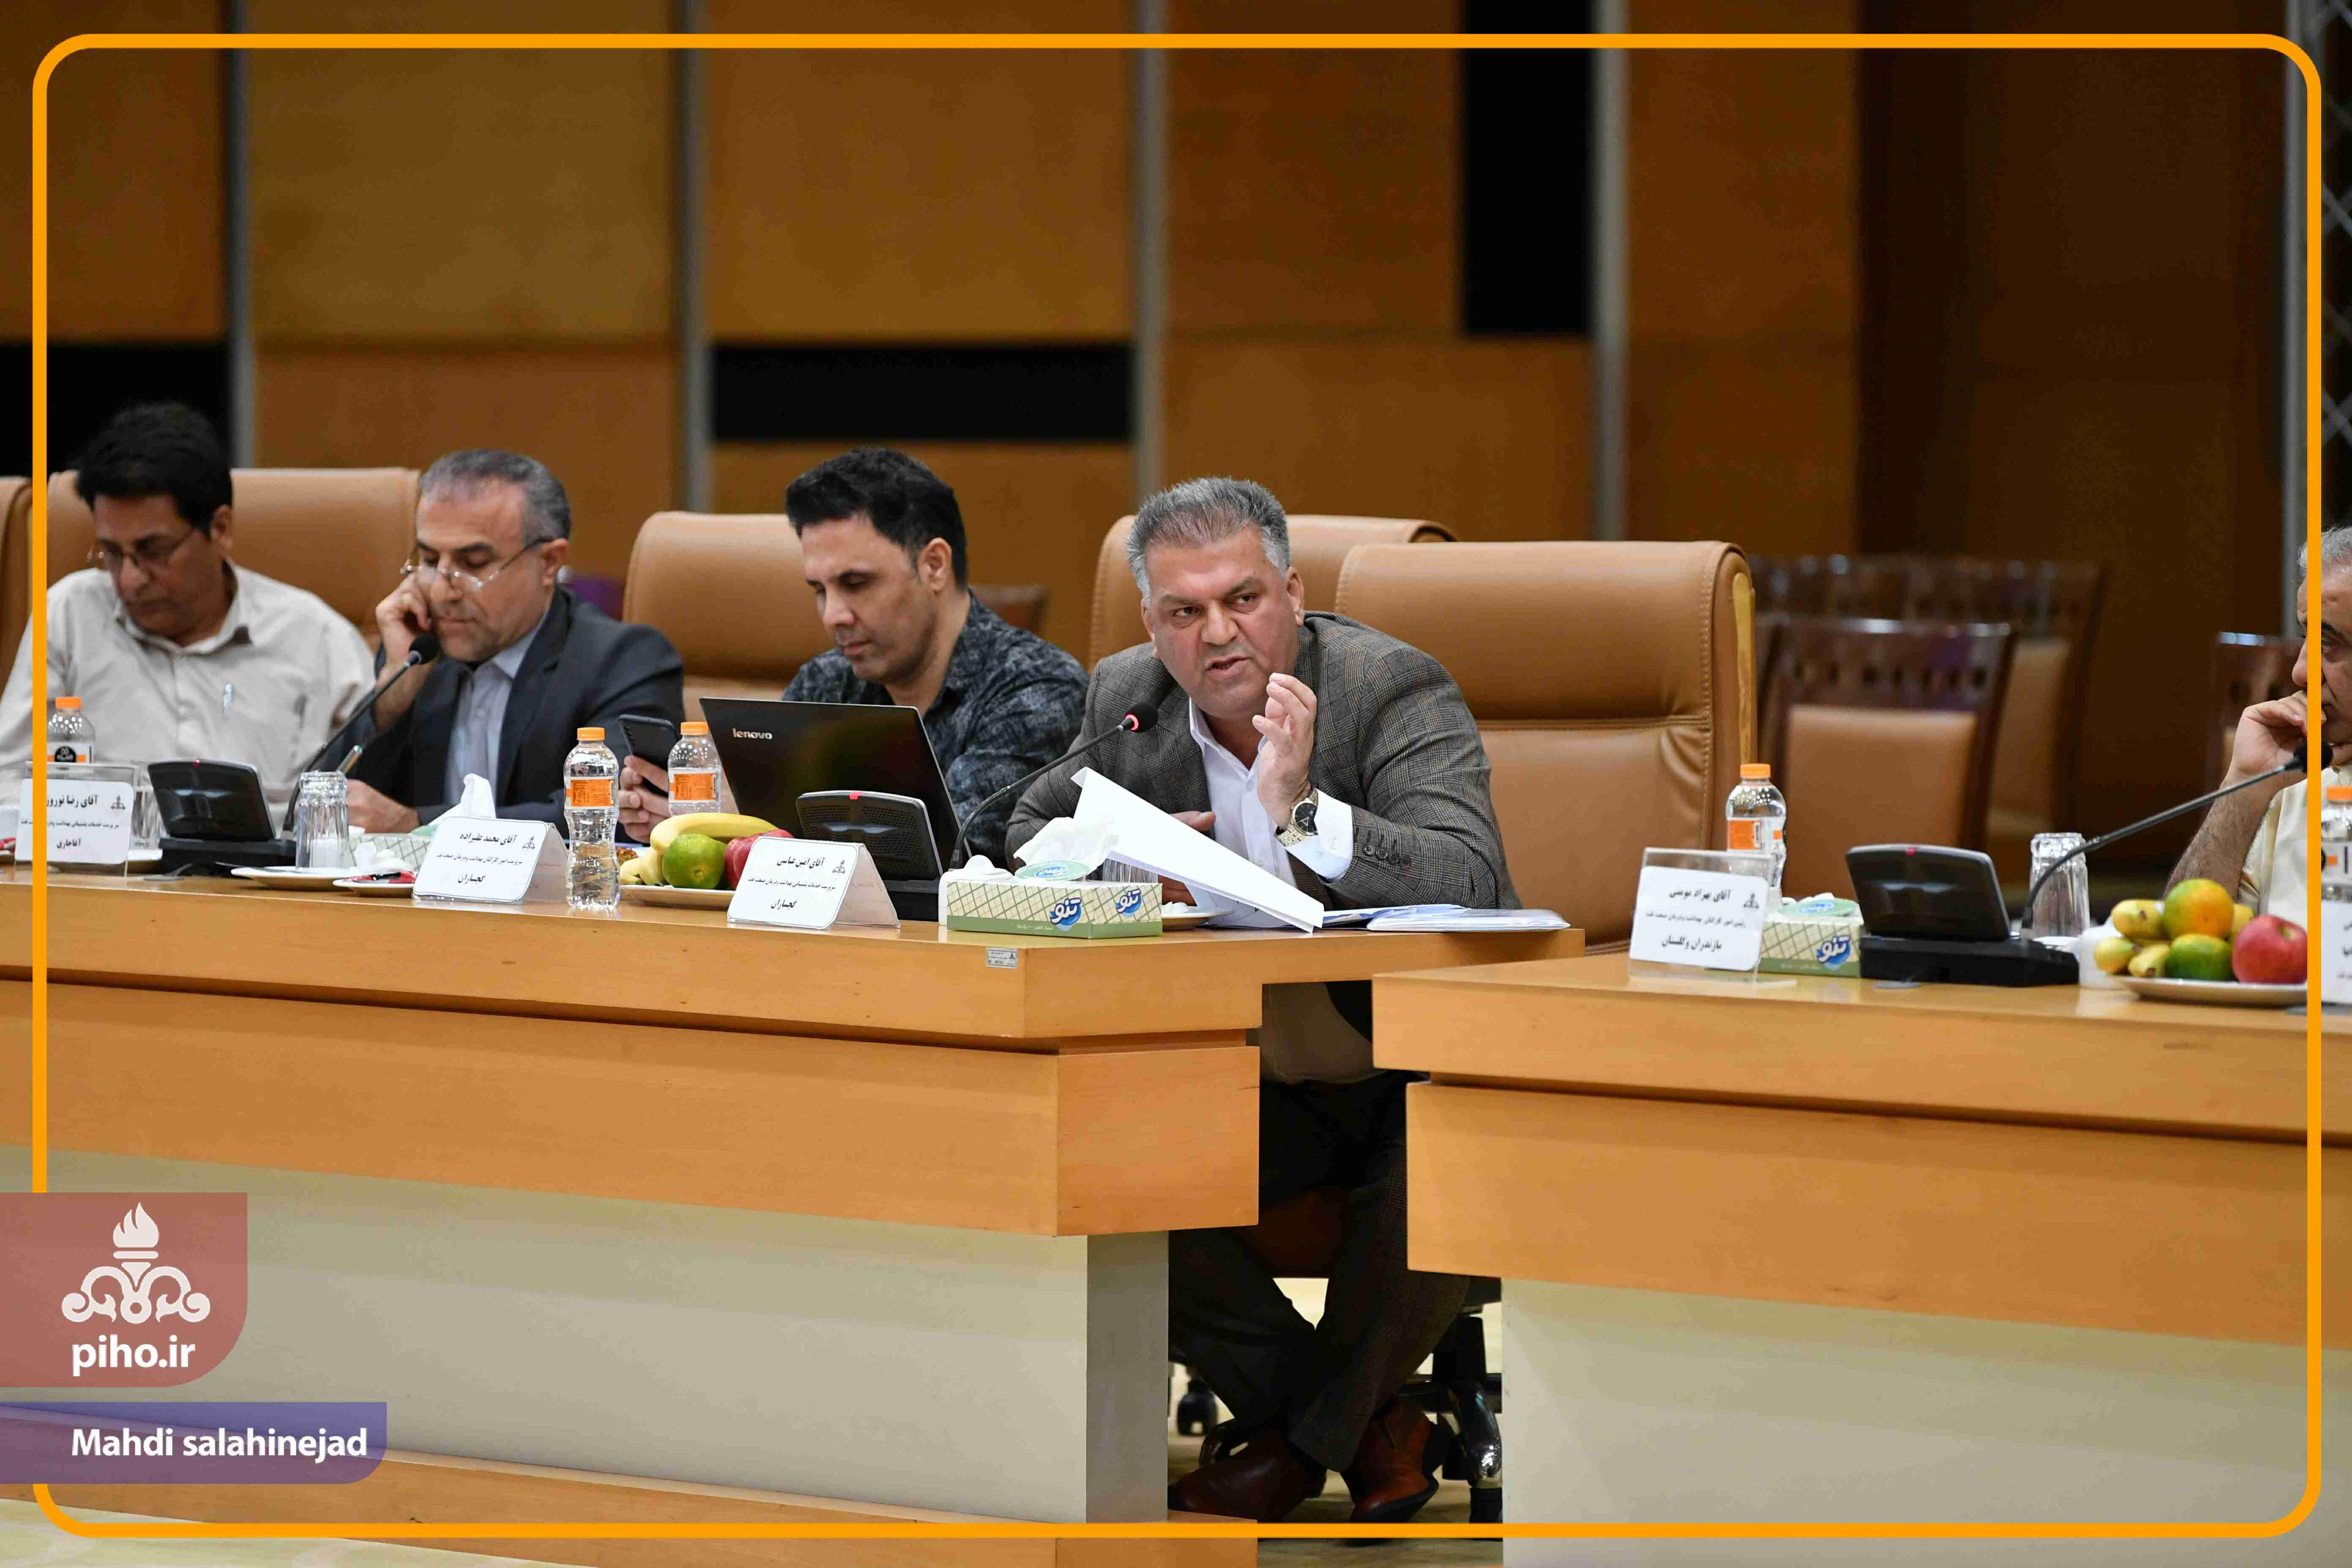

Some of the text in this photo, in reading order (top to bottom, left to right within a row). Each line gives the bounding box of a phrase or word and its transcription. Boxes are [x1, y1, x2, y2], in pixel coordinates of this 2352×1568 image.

[732, 728, 773, 739] lenovo
[46, 794, 65, 807] نوروز
[81, 794, 98, 808] آقای
[500, 834, 517, 846] آقای
[777, 856, 796, 866] عباسی
[809, 857, 826, 869] آقای
[1116, 888, 1141, 914] تنو
[1050, 897, 1082, 925] تنو
[1818, 935, 1851, 964] تنو
